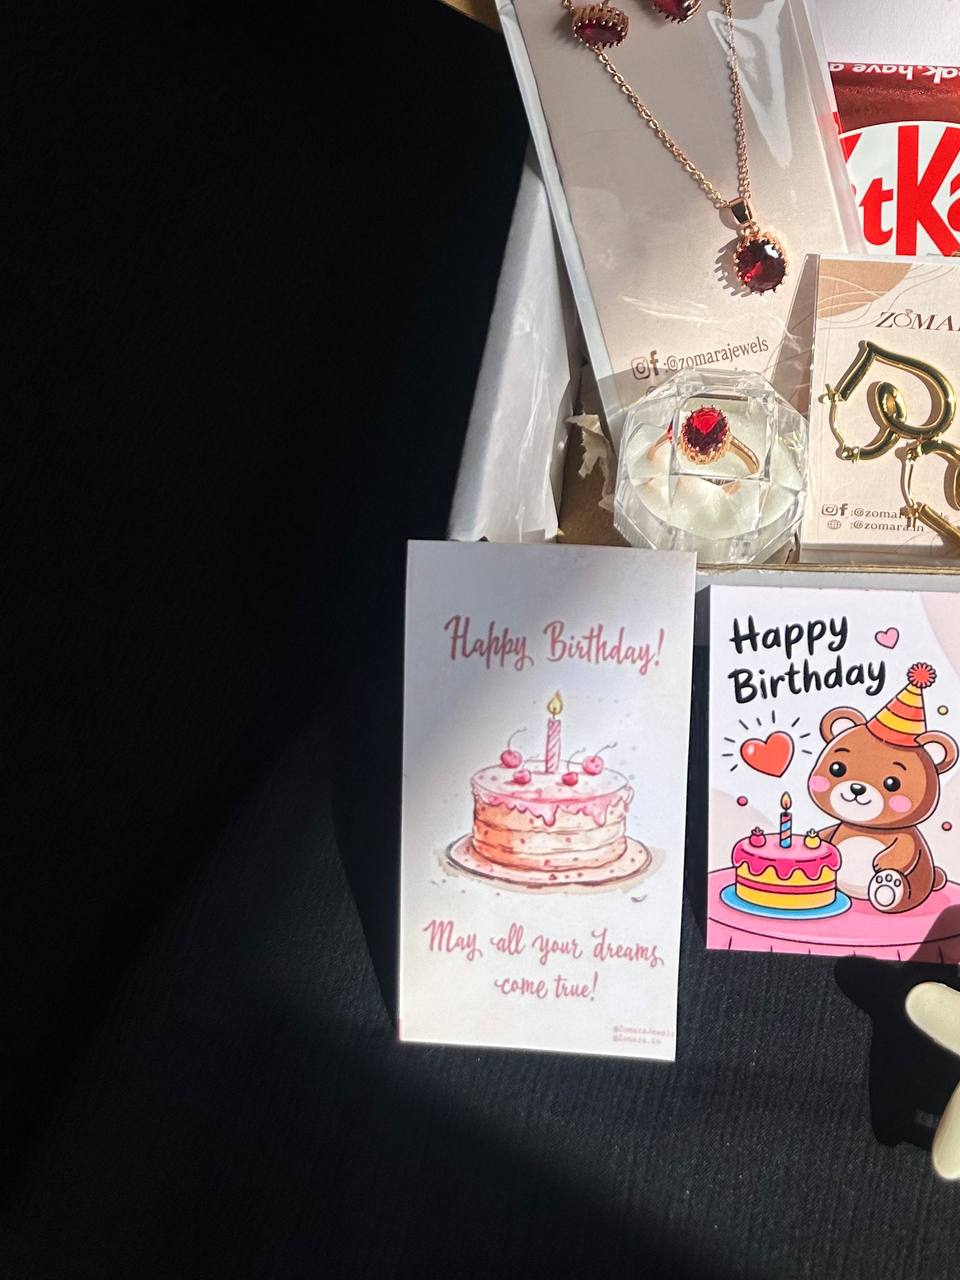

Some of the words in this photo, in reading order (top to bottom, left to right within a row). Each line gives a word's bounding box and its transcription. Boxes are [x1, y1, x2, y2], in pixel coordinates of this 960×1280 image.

[852, 63, 912, 81] have
[443, 614, 535, 671] Happy
[543, 620, 665, 675] Birthday!
[729, 615, 848, 659] Happy
[728, 654, 886, 704] Birthday
[423, 919, 483, 961] May
[490, 922, 525, 955] all
[531, 934, 583, 966] your
[592, 927, 664, 968] dreams
[494, 977, 548, 999] come
[555, 971, 599, 1001] true!
